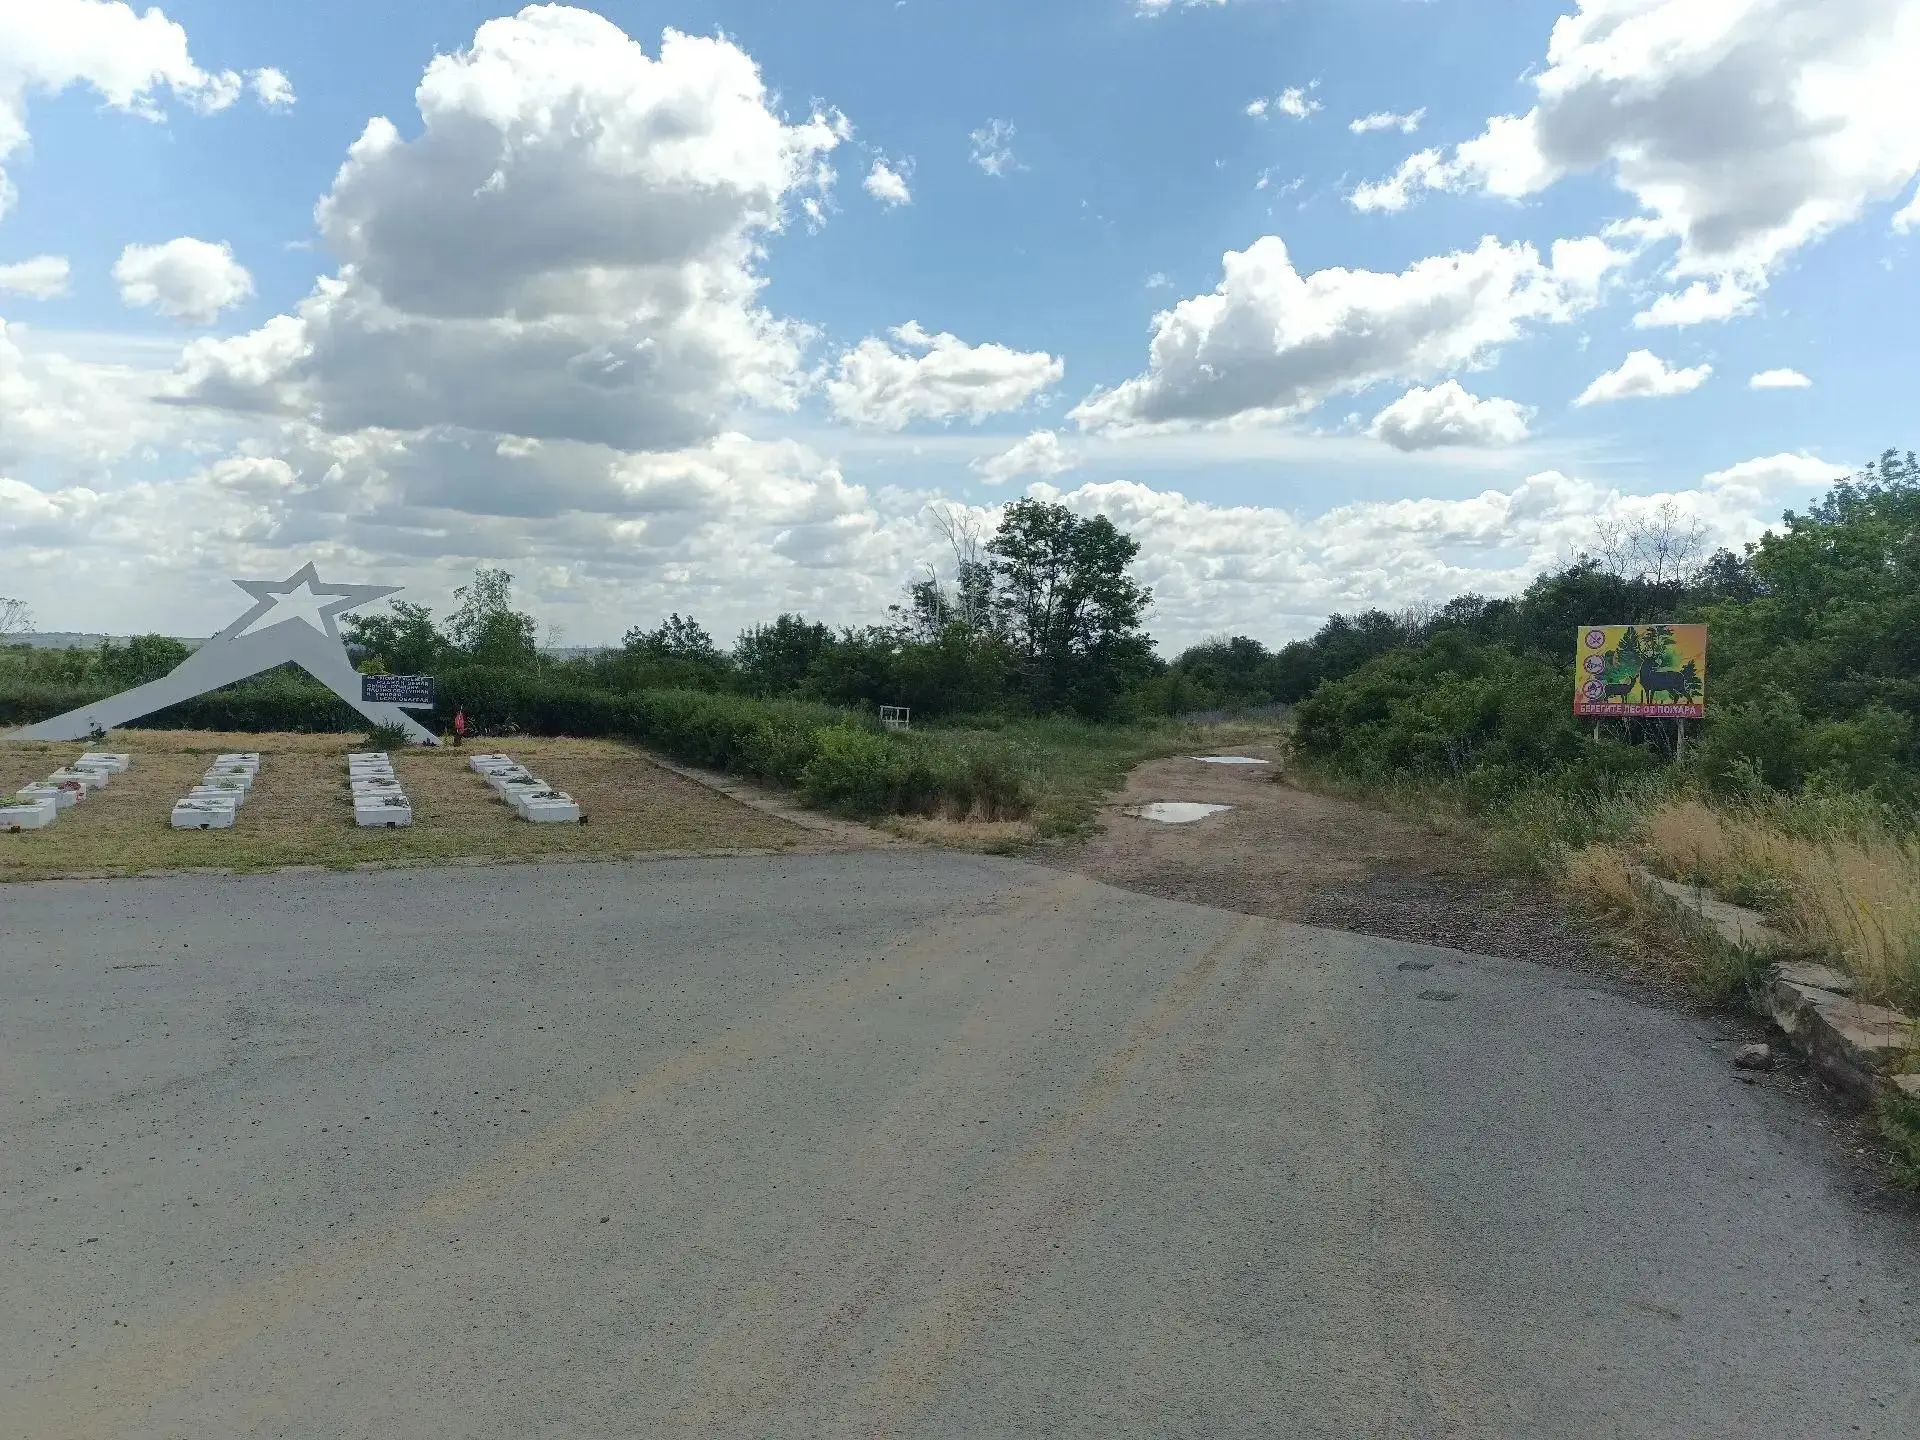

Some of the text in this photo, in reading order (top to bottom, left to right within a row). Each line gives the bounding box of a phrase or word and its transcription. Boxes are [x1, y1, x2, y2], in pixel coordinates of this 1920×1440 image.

[1580, 704, 1696, 715] БЕРЕГИТЕ ЛЕС ОТ ПОЖАРА
